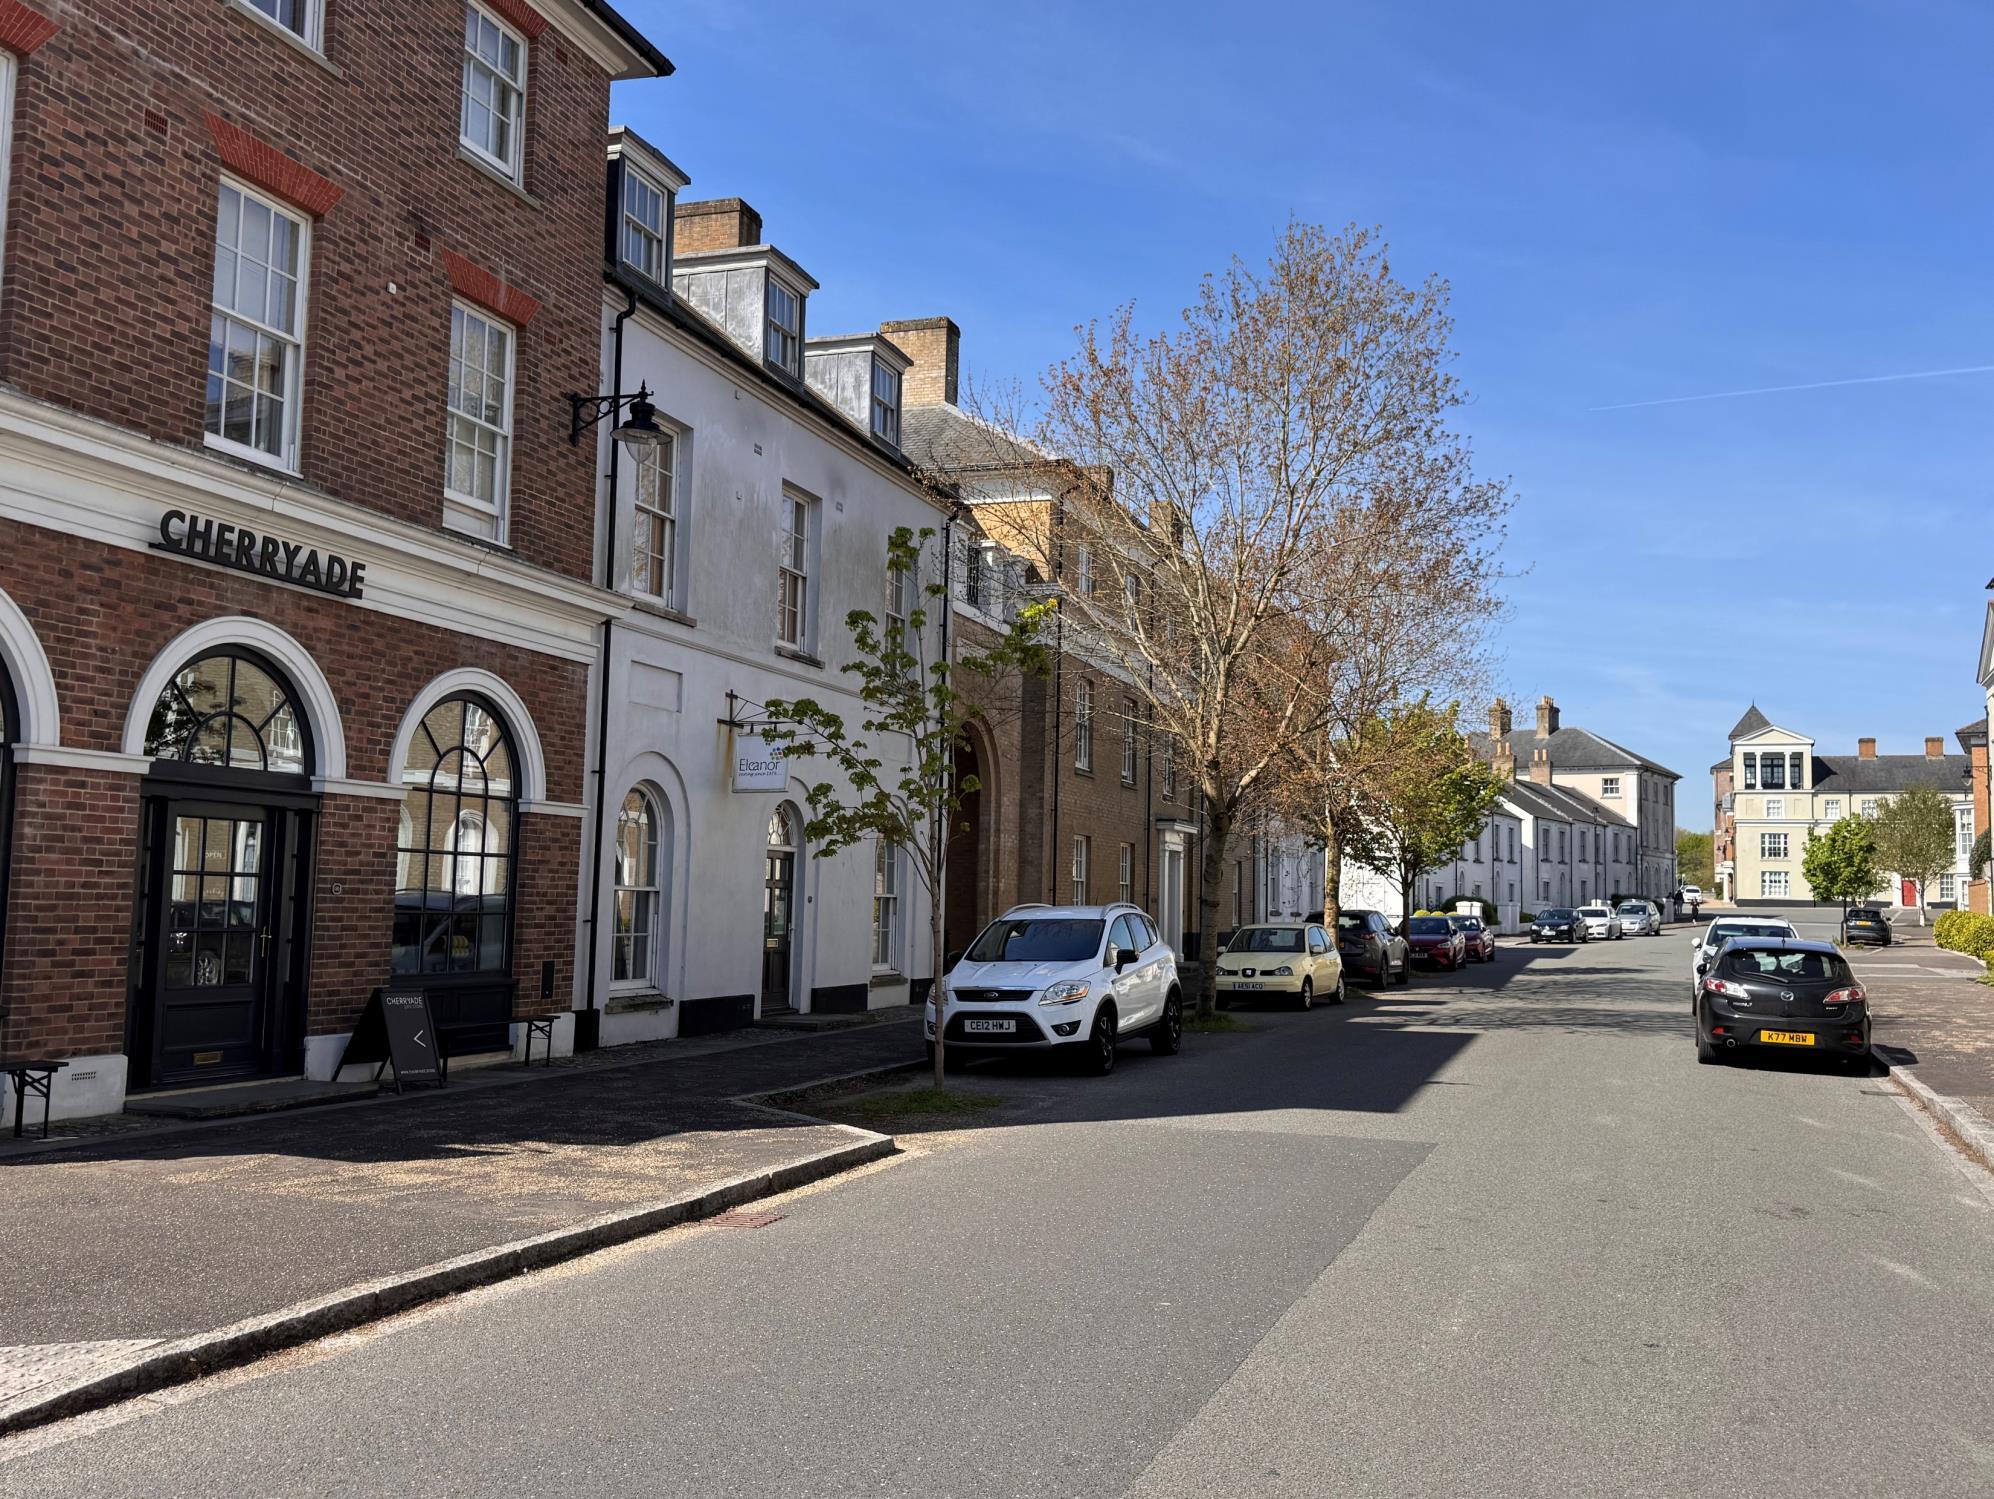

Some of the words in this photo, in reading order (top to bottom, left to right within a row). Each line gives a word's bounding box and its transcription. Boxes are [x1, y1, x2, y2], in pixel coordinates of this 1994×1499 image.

[160, 510, 366, 599] CHERRYADE
[739, 758, 780, 771] Eleanor
[386, 996, 423, 1005] CHERRYADE
[970, 1020, 991, 1031] CE12
[992, 1020, 1011, 1031] HWJ
[1767, 1032, 1786, 1042] K77
[1788, 1033, 1807, 1043] MBW
